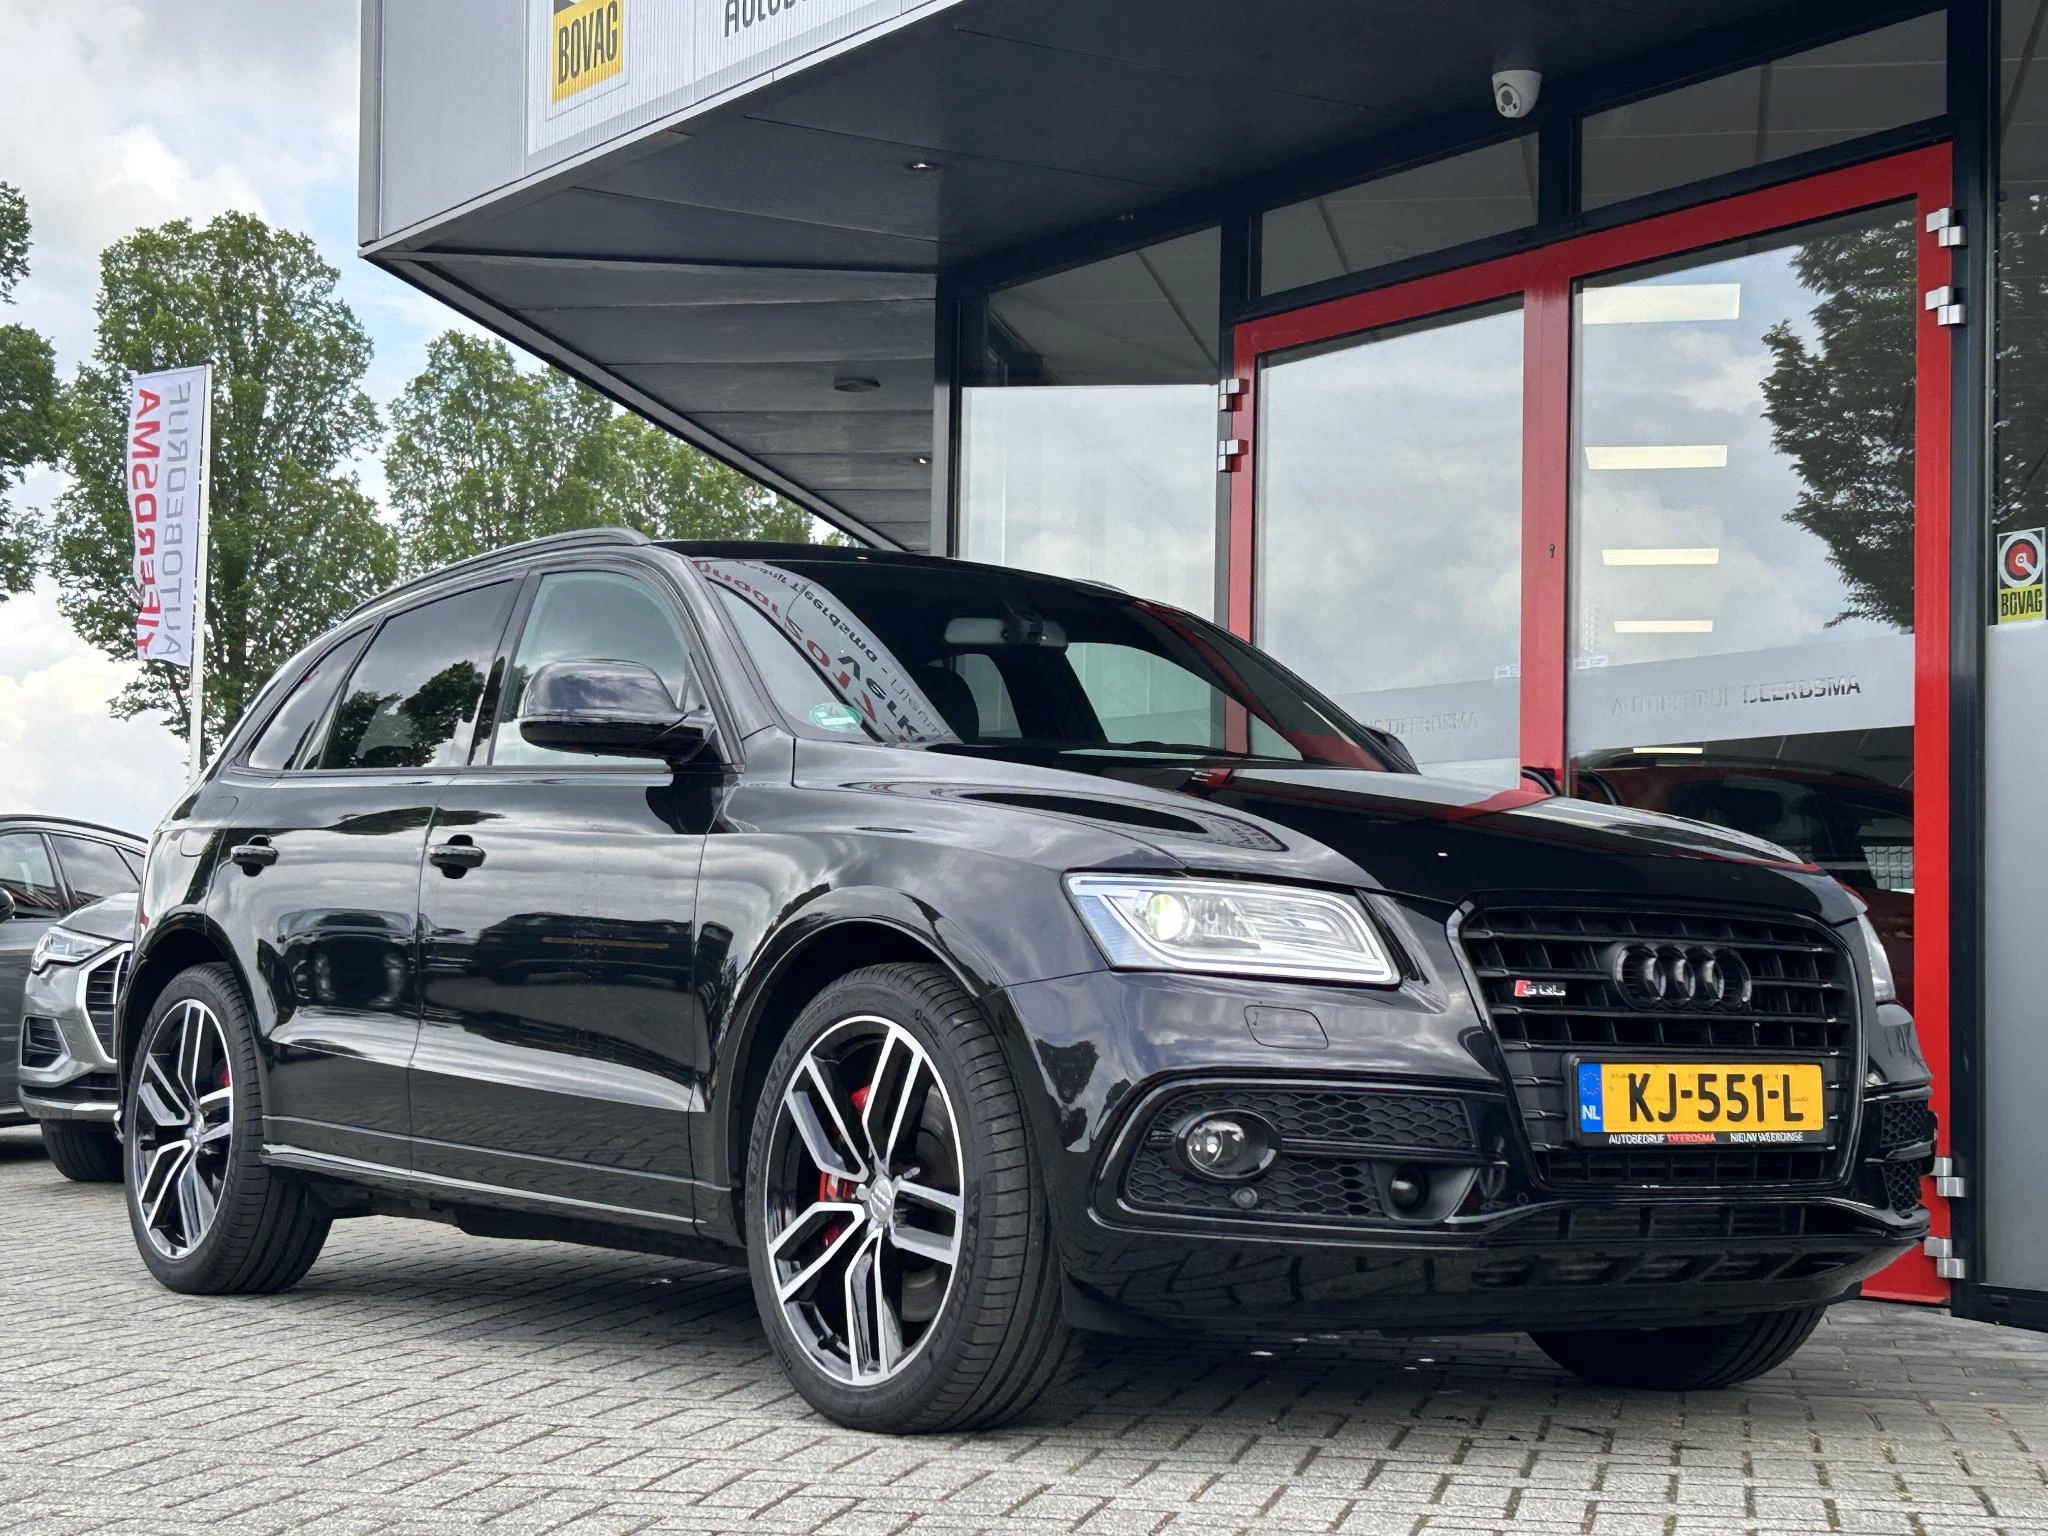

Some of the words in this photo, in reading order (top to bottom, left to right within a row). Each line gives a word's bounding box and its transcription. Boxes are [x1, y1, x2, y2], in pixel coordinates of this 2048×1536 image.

[558, 0, 618, 86] BOVAG
[2001, 588, 2043, 617] BOVAG
[1582, 1105, 1601, 1121] NL
[1628, 1072, 1804, 1123] KJ-551-L
